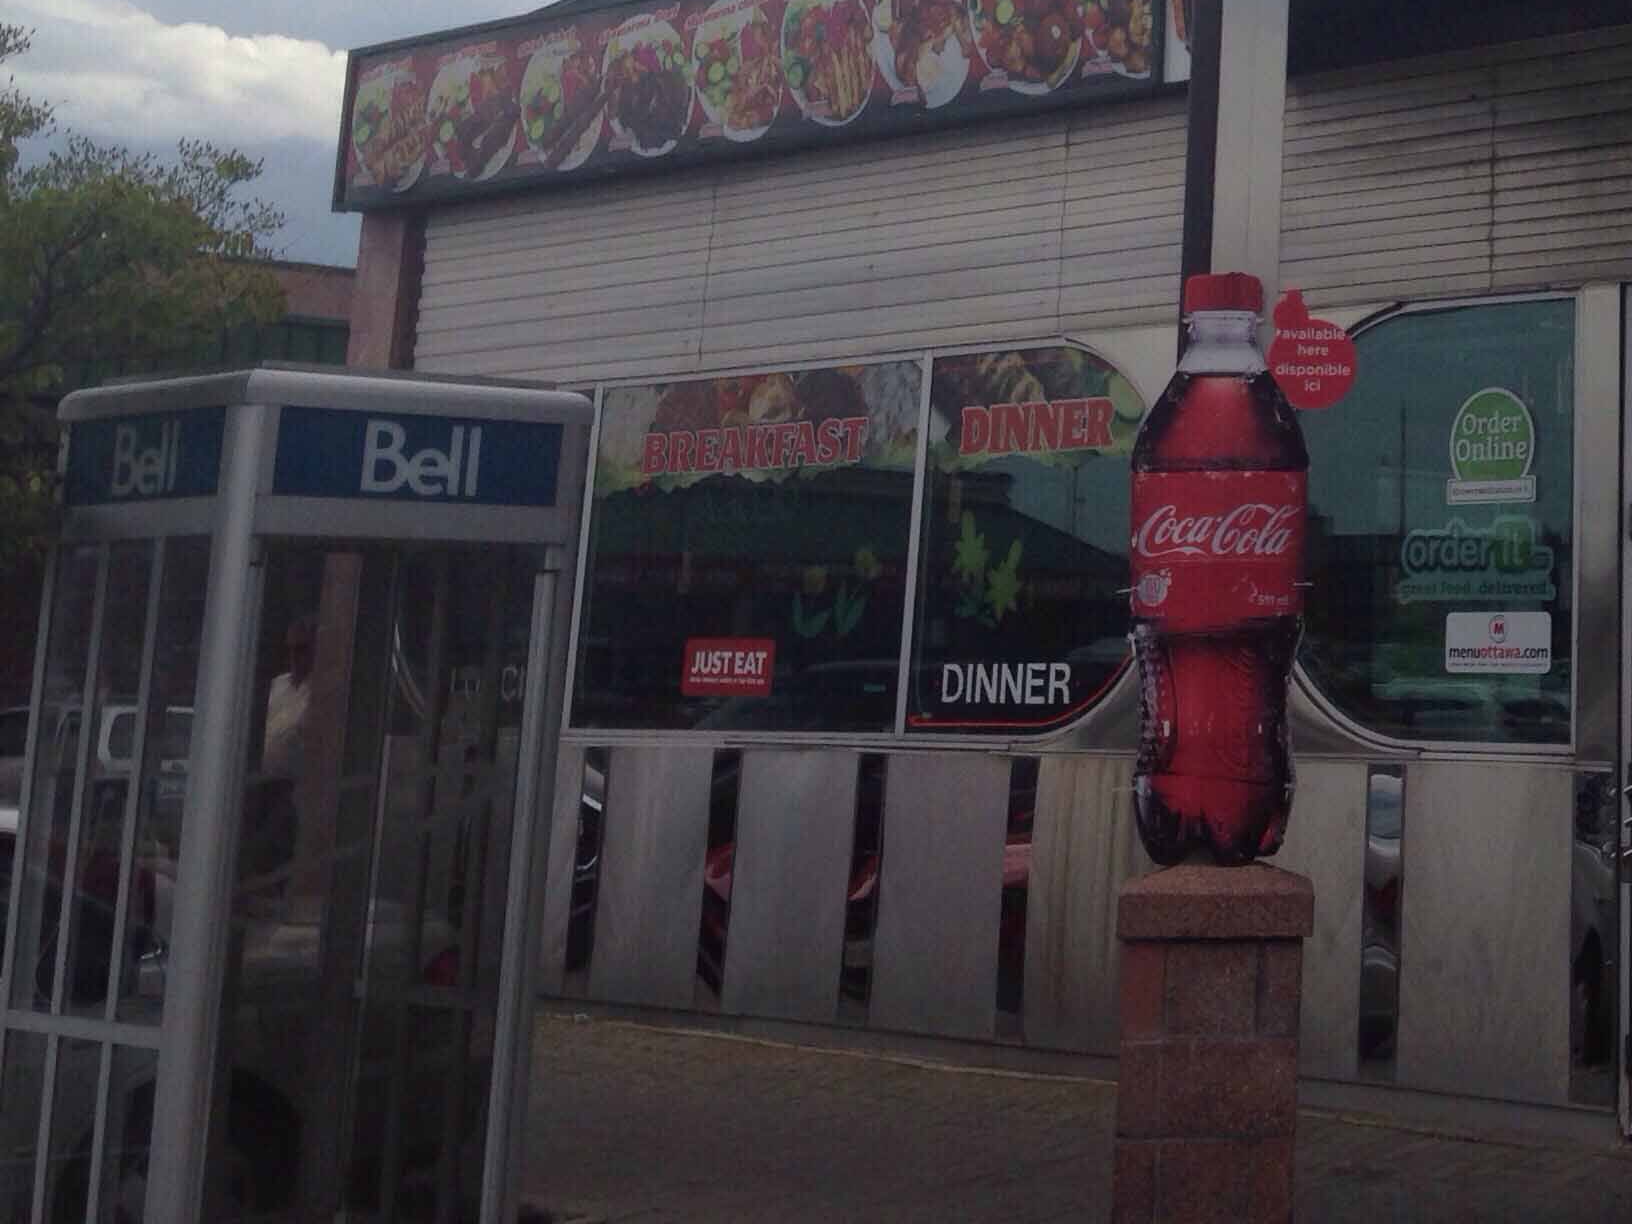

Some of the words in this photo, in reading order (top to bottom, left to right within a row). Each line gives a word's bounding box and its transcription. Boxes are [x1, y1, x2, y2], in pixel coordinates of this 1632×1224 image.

[1280, 327, 1346, 341] available
[1297, 343, 1329, 357] here
[1274, 362, 1352, 377] disponible
[1304, 378, 1321, 392] ici
[959, 396, 1115, 456] DINNER
[1461, 409, 1522, 435] Order
[111, 420, 180, 497] Bell
[358, 418, 482, 498] Bell
[640, 416, 869, 475] BREAKFAST
[1455, 434, 1529, 461] Online
[1137, 503, 1302, 558] Coca-Cola
[691, 650, 733, 675] JUST
[734, 650, 768, 675] EAT
[1448, 645, 1548, 660] menuottawa.com
[940, 660, 1072, 706] DINNER
